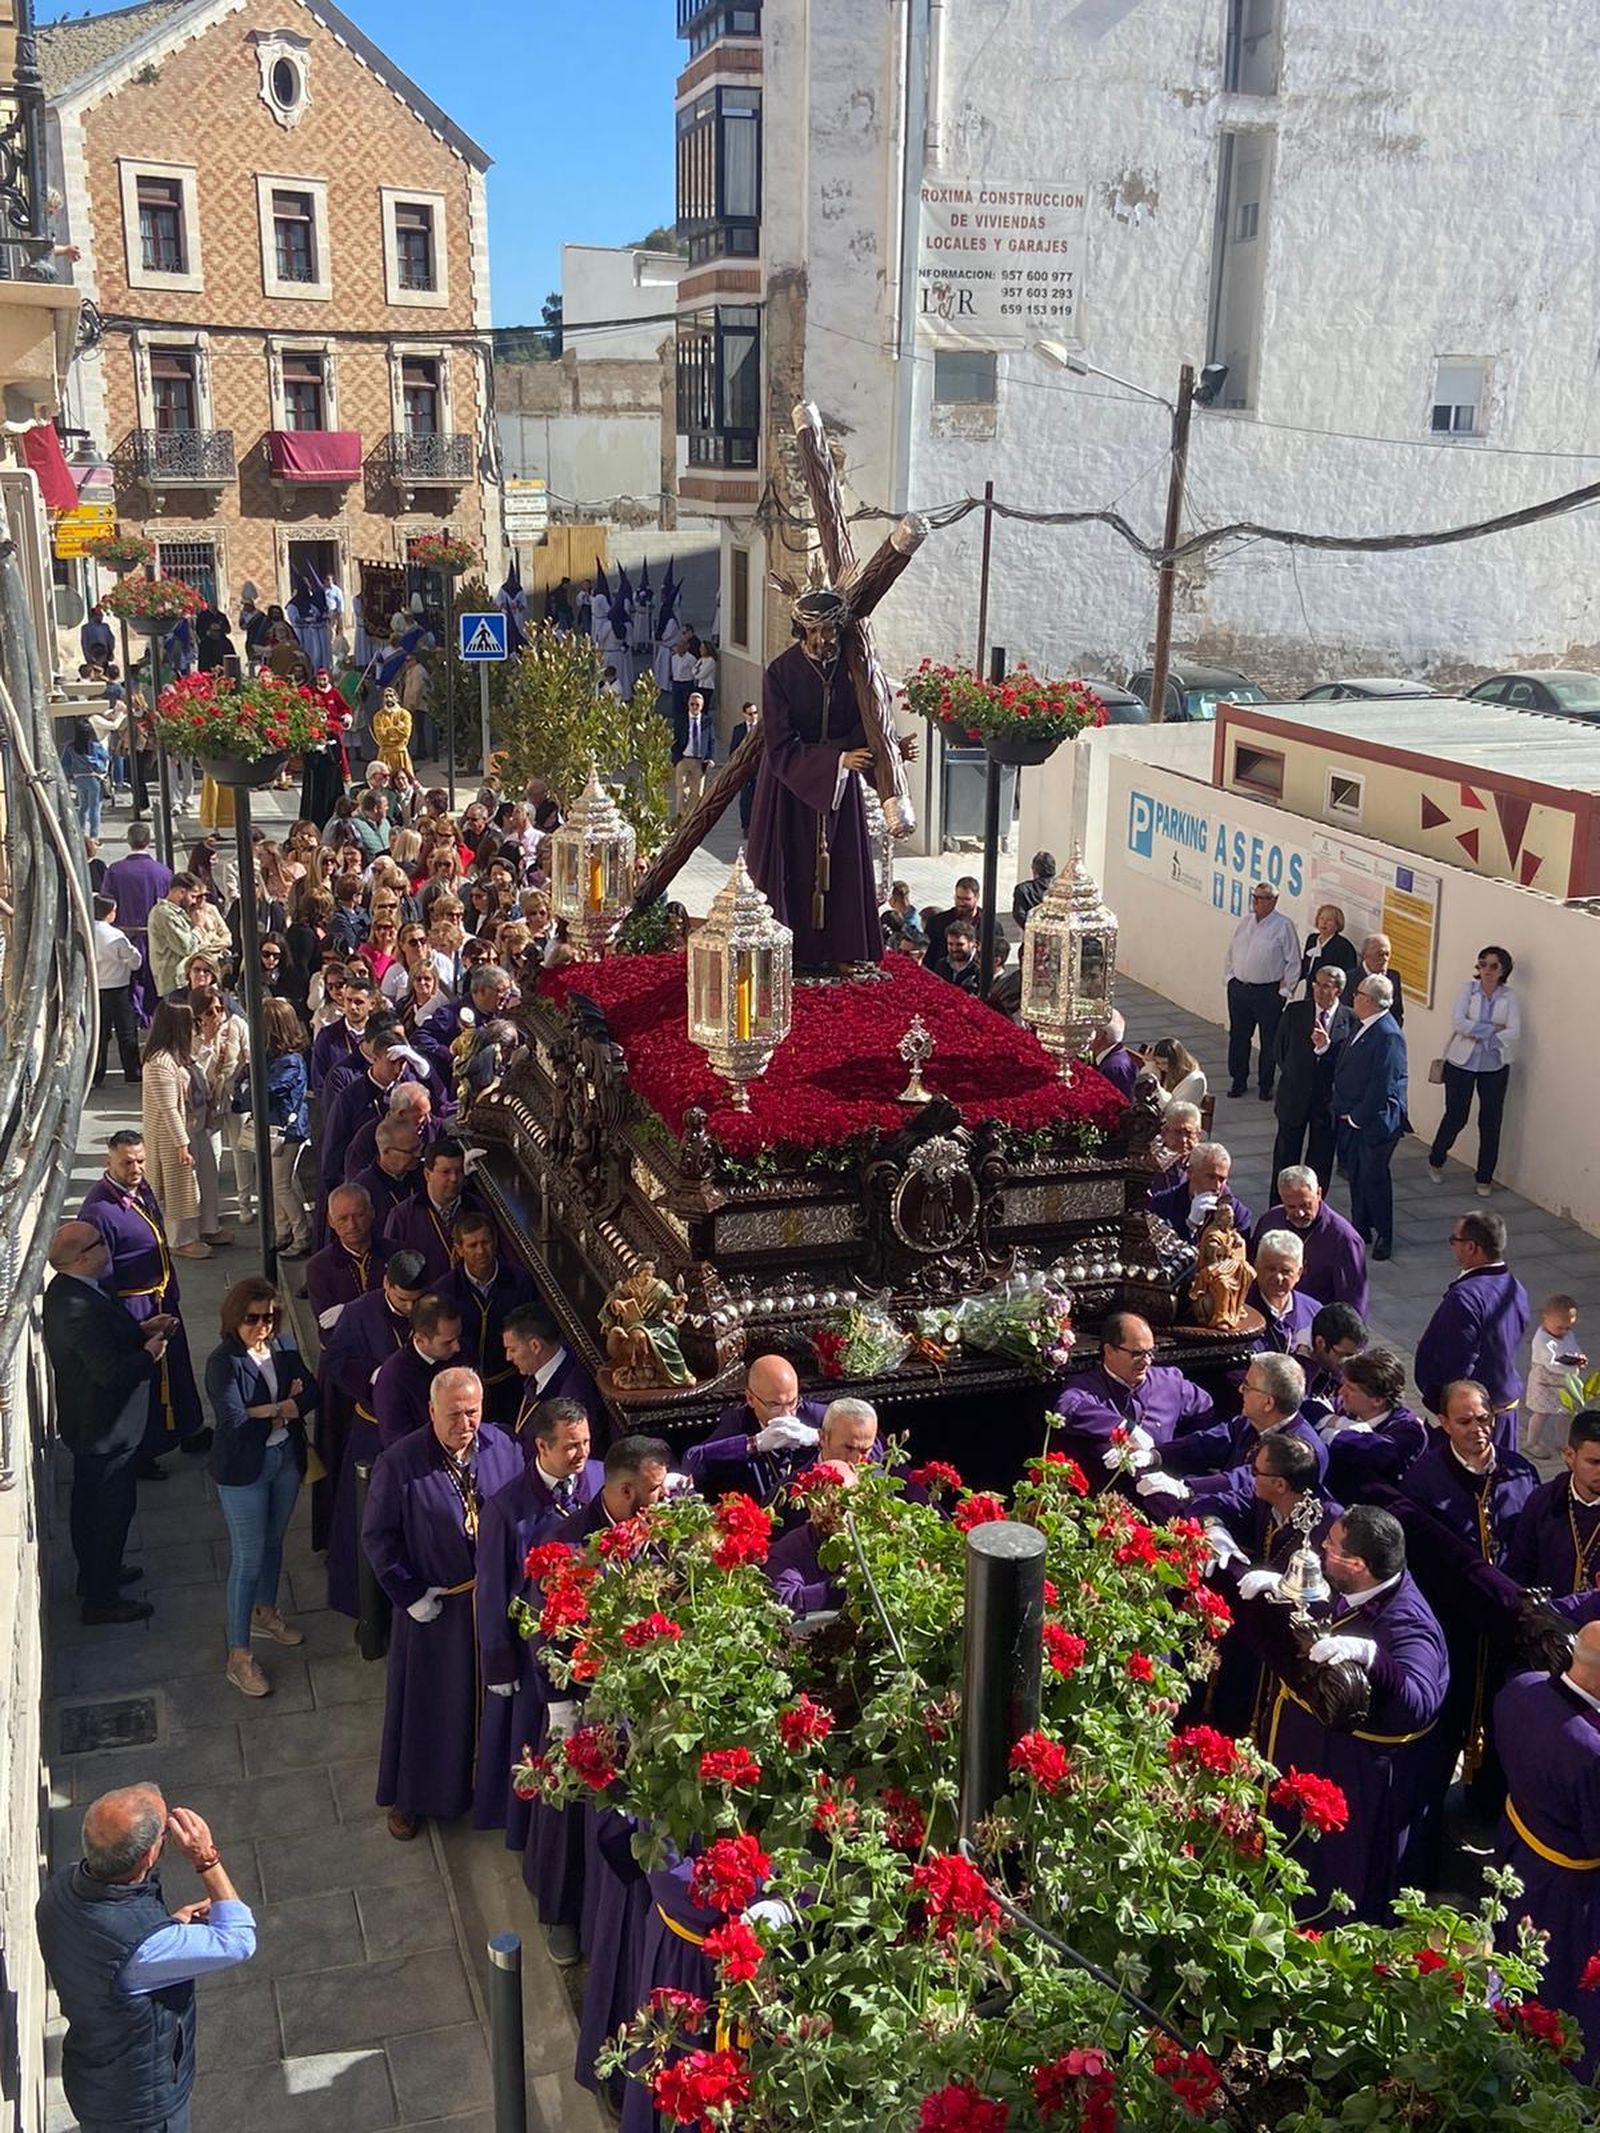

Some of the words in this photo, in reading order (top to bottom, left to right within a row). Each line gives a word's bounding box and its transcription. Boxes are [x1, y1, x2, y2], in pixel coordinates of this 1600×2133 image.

[921, 188, 974, 203] ROXIMA
[980, 191, 1084, 208] CONSTRUCCION
[951, 213, 968, 228] DE
[975, 214, 1046, 229] VIVIENDAS
[926, 236, 987, 251] LOCALES
[994, 238, 1002, 251] Y
[1008, 239, 1068, 253] GARAJES
[918, 269, 996, 280] NFORMACION:
[1001, 270, 1023, 281] 957
[1026, 271, 1048, 281] 600
[1051, 271, 1073, 282] 977
[1001, 287, 1023, 298] 957
[1026, 288, 1048, 298] 603
[1051, 288, 1073, 299] 293
[1000, 304, 1022, 315] 659
[1027, 304, 1047, 316] 153
[1050, 305, 1072, 316] 919
[1131, 796, 1151, 849] P
[1155, 801, 1207, 853] PARKING
[1214, 823, 1303, 897] ASEOS
